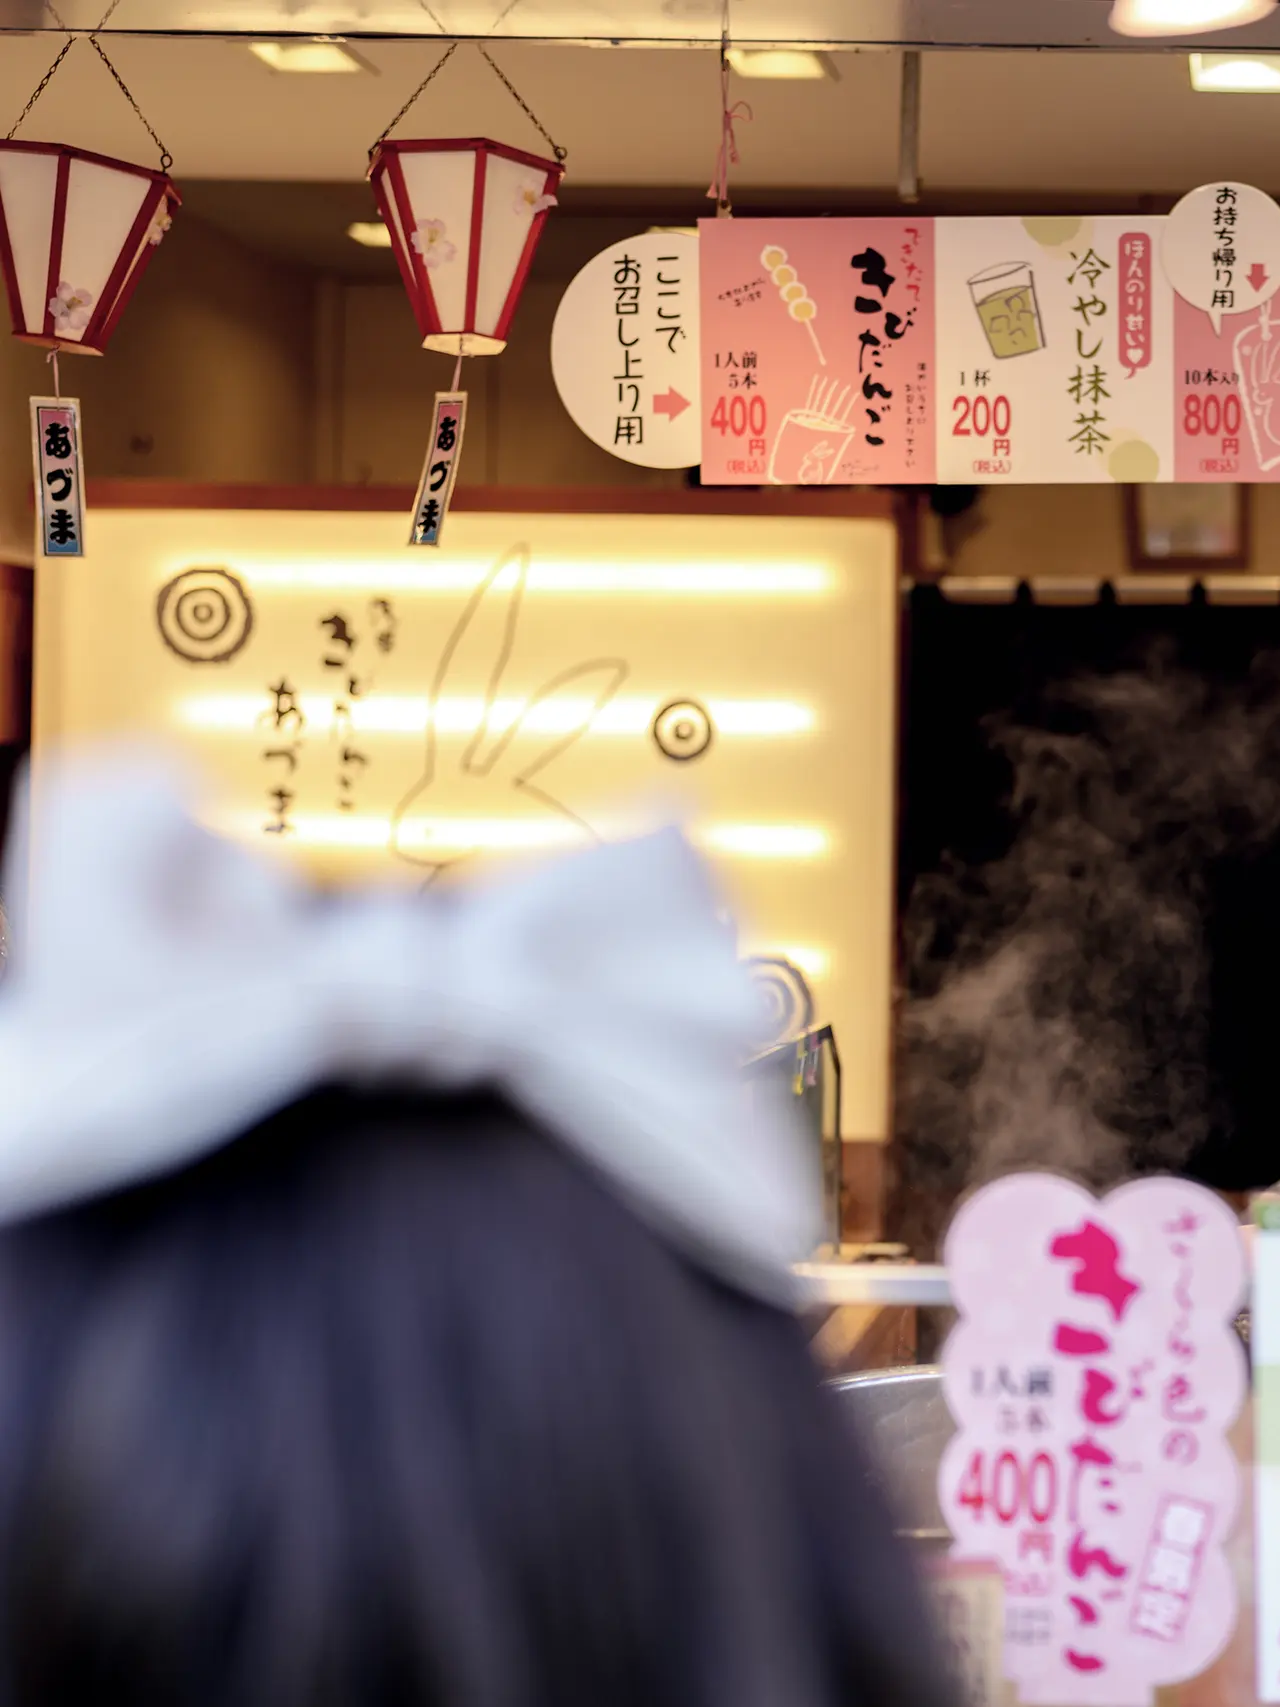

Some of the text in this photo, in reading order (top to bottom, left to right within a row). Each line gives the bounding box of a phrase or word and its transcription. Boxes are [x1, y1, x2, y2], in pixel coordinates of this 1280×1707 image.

[1211, 187, 1238, 309] お持ち帰り用
[655, 256, 687, 354] ここで
[1124, 240, 1146, 347] ほんのり甘い
[613, 253, 644, 445] お召し上り用
[714, 352, 758, 370] 1人前
[729, 373, 758, 390] 5本
[851, 247, 918, 446] きびだんご
[1066, 248, 1112, 455] 冷やし抹茶
[711, 394, 767, 437] 400
[749, 439, 766, 456] 円
[952, 394, 1012, 437] 200
[993, 438, 1011, 457] 円
[1183, 394, 1241, 436] 800
[1222, 438, 1239, 456] 円
[45, 422, 76, 545] あづま
[418, 416, 457, 533] あづま
[957, 1448, 1059, 1524] 400
[1049, 1218, 1154, 1675] きびだんご
